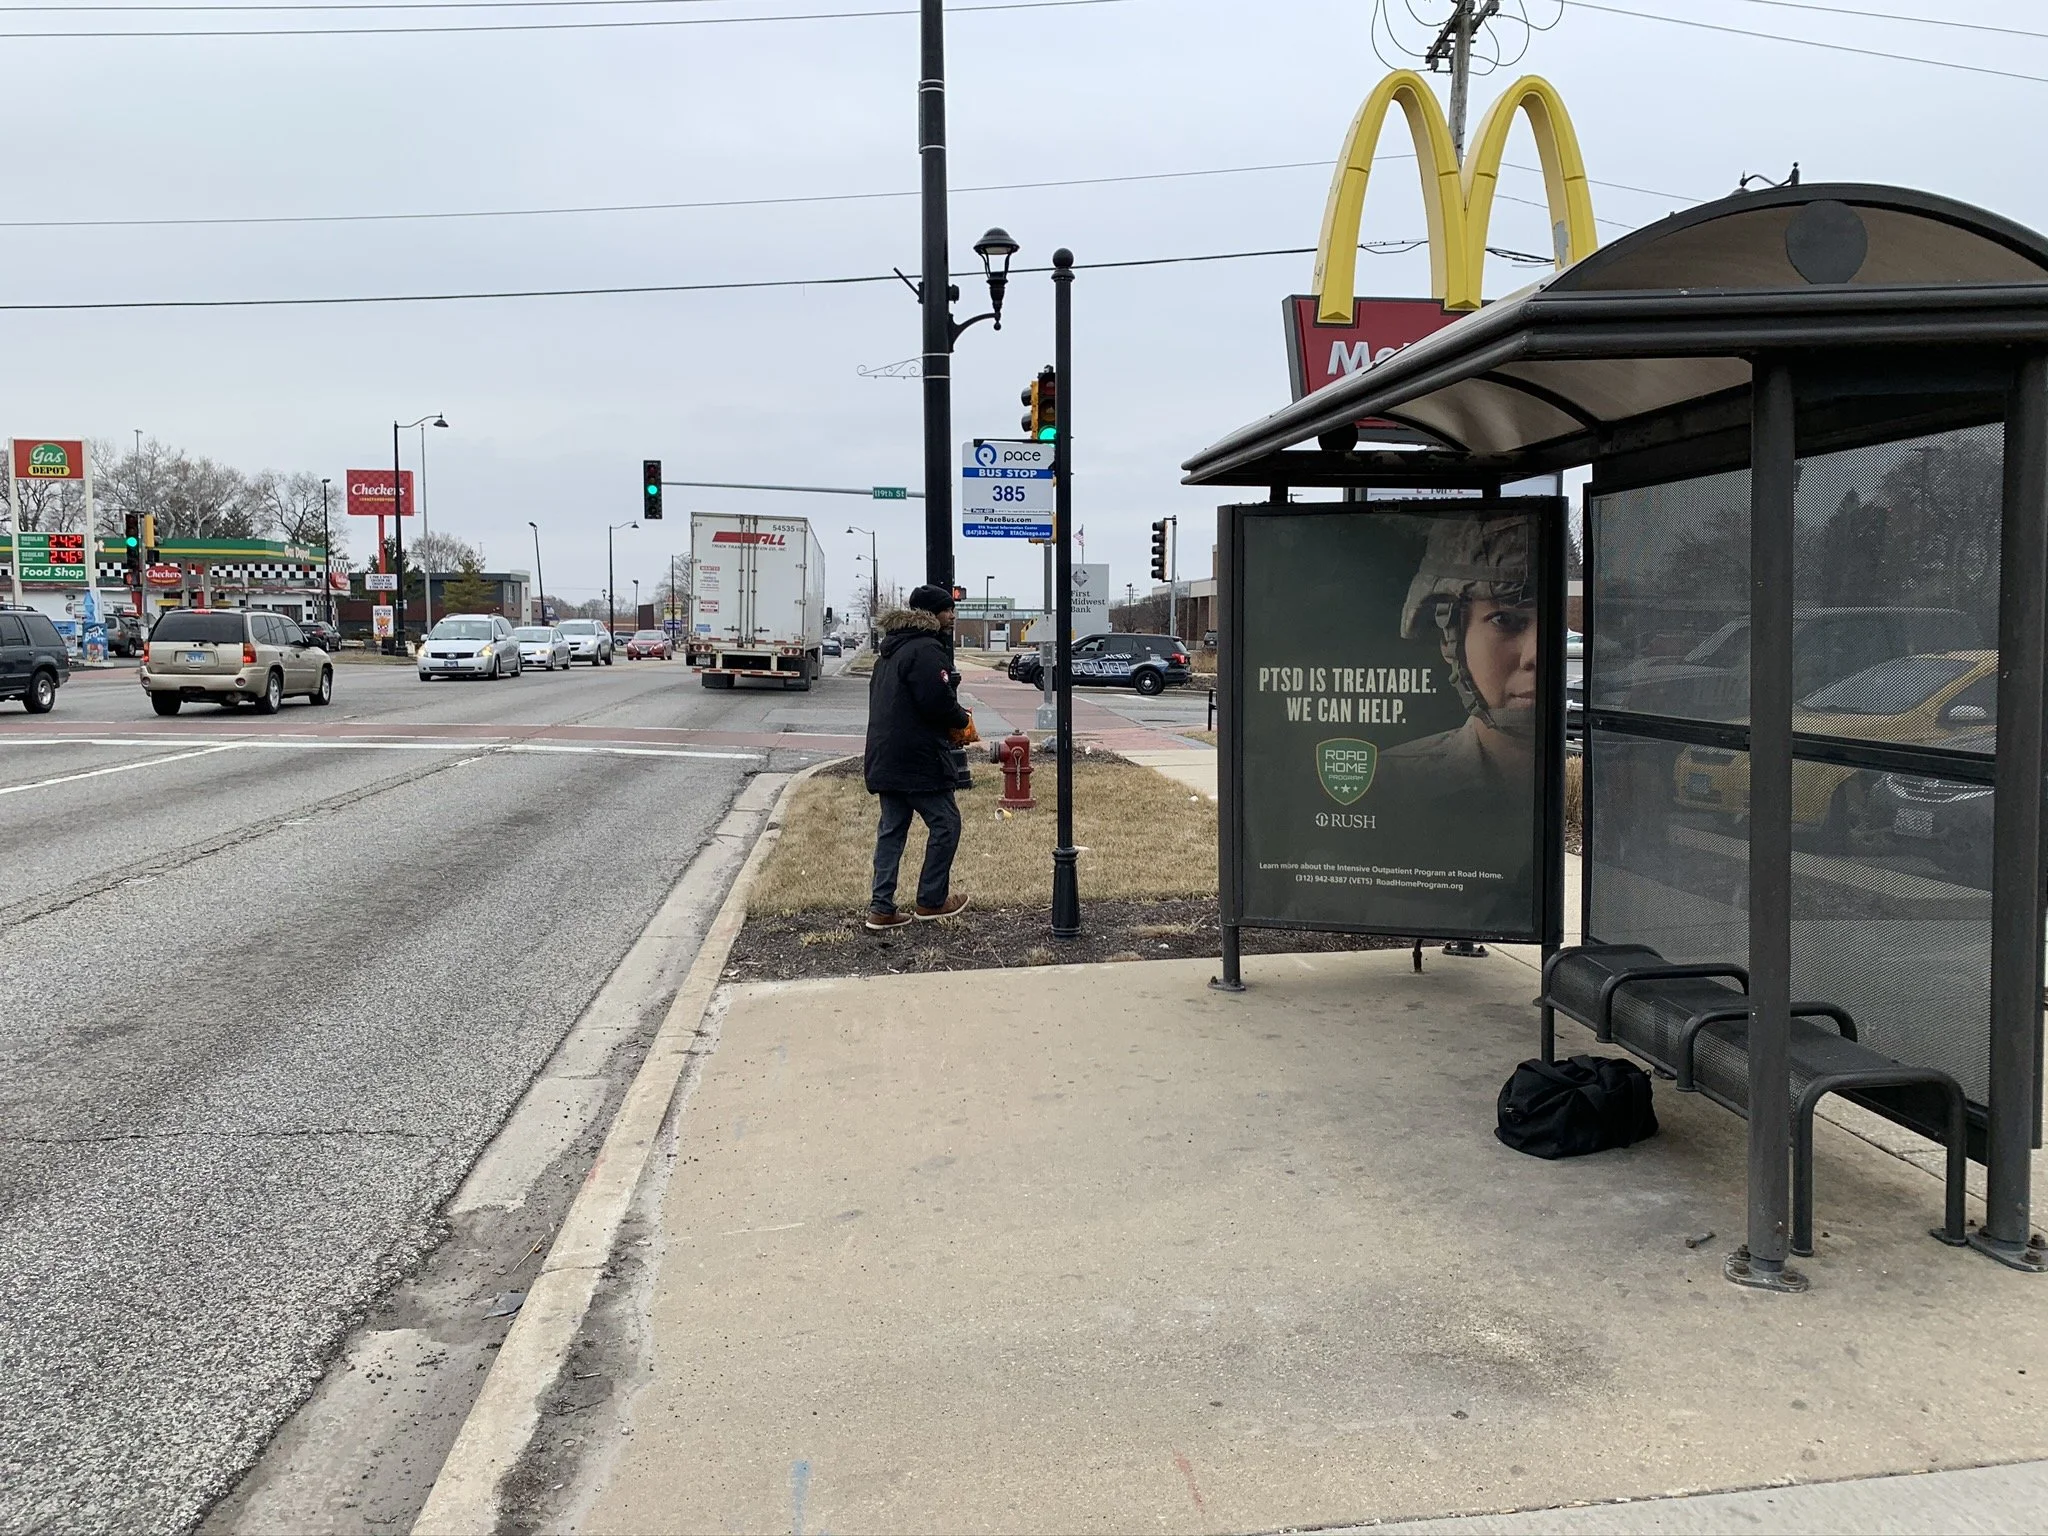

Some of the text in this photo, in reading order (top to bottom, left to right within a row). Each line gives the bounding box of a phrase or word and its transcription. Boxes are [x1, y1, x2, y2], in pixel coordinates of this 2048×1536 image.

[32, 446, 64, 464] Gas
[1003, 450, 1042, 463] pace
[32, 466, 67, 475] DEPOT
[978, 468, 1038, 478] BUS STOP
[351, 483, 406, 496] Checkes
[874, 489, 905, 498] 119th St
[992, 485, 1026, 502] 385
[772, 524, 796, 533] 54535
[759, 533, 786, 546] ALL
[22, 567, 84, 578] Food Shop
[146, 569, 182, 578] Checkers
[1071, 661, 1131, 675] POLICE
[1259, 667, 1437, 694] PTSD IS TREATABLE.
[1286, 697, 1407, 724] WE CAN HELP.
[1325, 749, 1368, 761] ROAD
[1324, 761, 1368, 774] HOME
[1331, 813, 1377, 829] RUSH
[1259, 862, 1279, 870] Learn
[1300, 862, 1322, 871] about
[1323, 863, 1336, 871] the
[1337, 864, 1370, 873] Intensive
[1371, 866, 1412, 876] Outpatient
[1414, 868, 1446, 878] Program
[1457, 870, 1477, 878] Road
[1478, 871, 1504, 880] Home.
[1295, 874, 1464, 891] (312) 942-8387 (VETS) RoadHomeProgram.org
